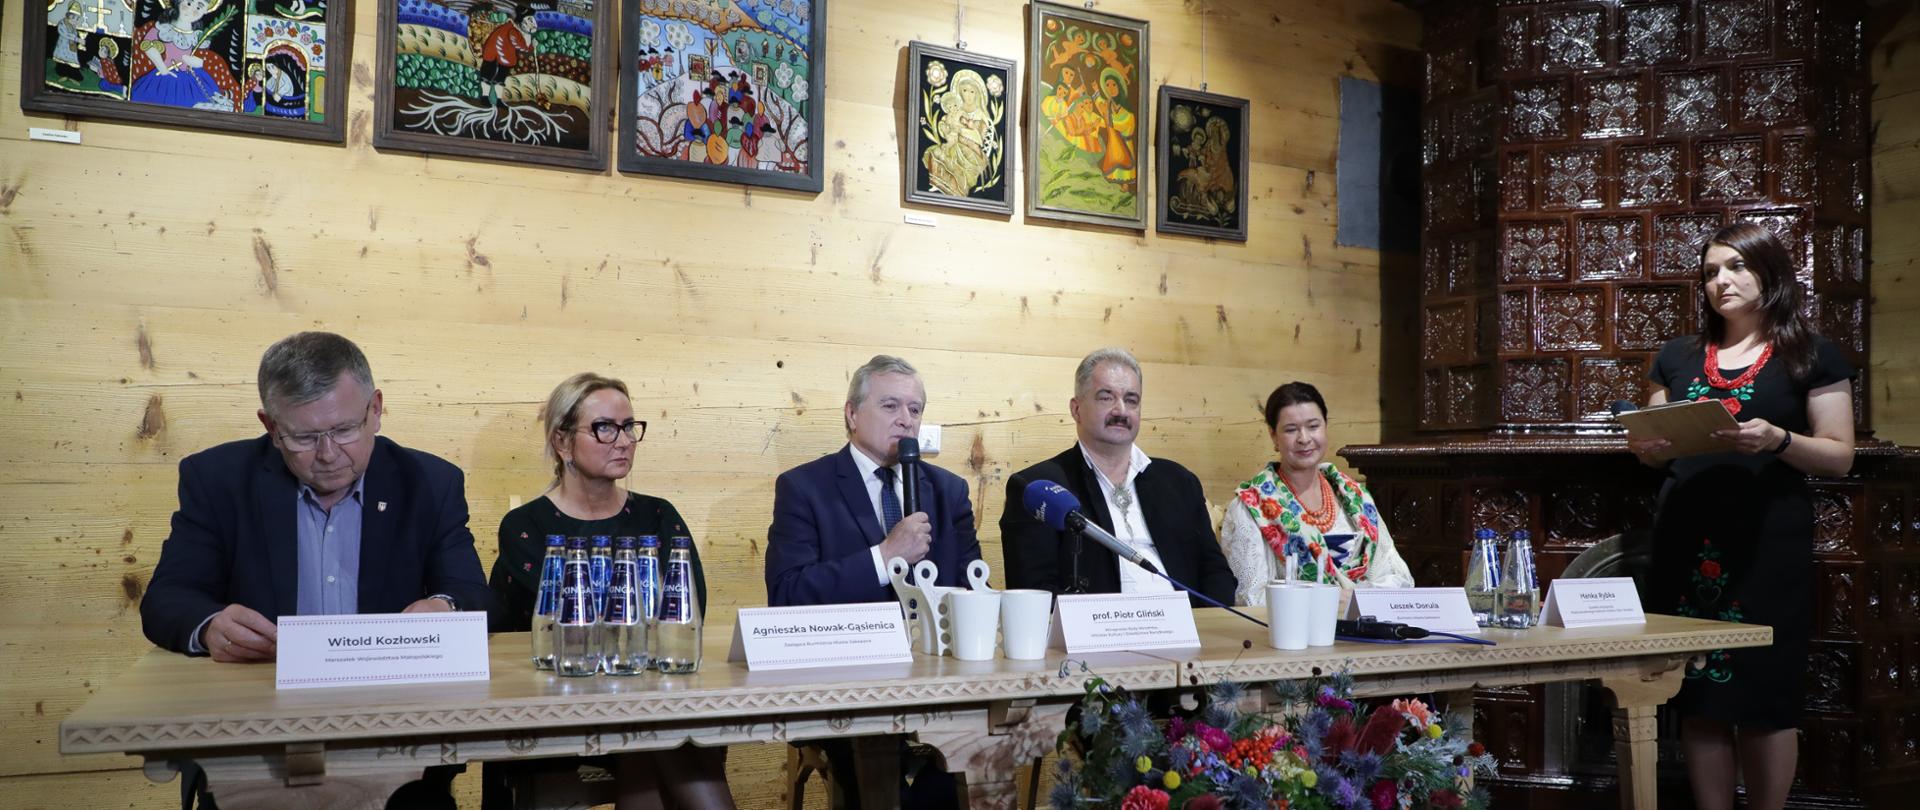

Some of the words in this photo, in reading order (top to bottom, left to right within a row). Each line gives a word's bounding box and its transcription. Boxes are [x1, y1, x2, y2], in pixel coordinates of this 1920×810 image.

[1092, 611, 1112, 620] prof.
[1114, 610, 1134, 619] Piotr
[1136, 609, 1165, 618] Gliński
[752, 625, 807, 637] Agnieszka
[809, 621, 895, 633] Nowak-Gąsienica
[328, 636, 372, 647] Witold
[376, 634, 440, 646] Kozłowski
